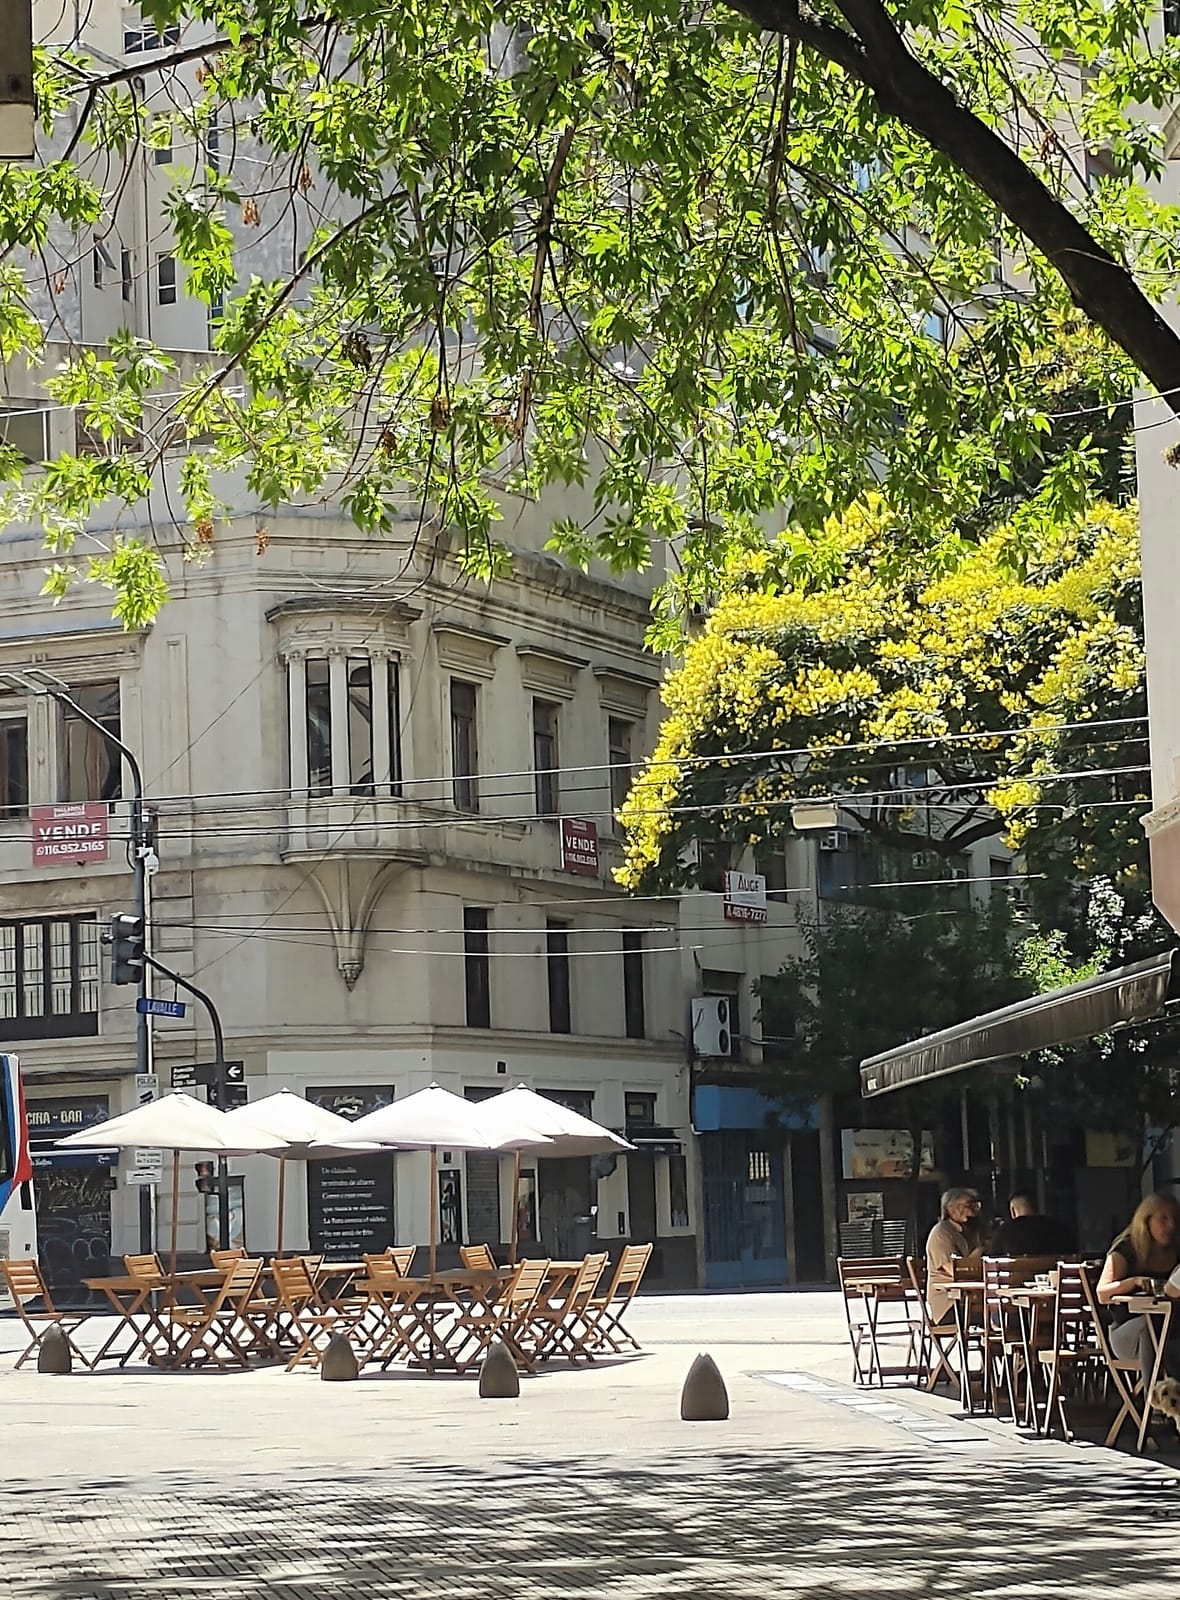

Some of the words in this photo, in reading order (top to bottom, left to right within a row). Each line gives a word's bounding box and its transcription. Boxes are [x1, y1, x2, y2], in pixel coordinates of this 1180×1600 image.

[39, 823, 101, 841] VENDE
[566, 835, 595, 852] VENDE
[61, 1110, 82, 1124] BAR
